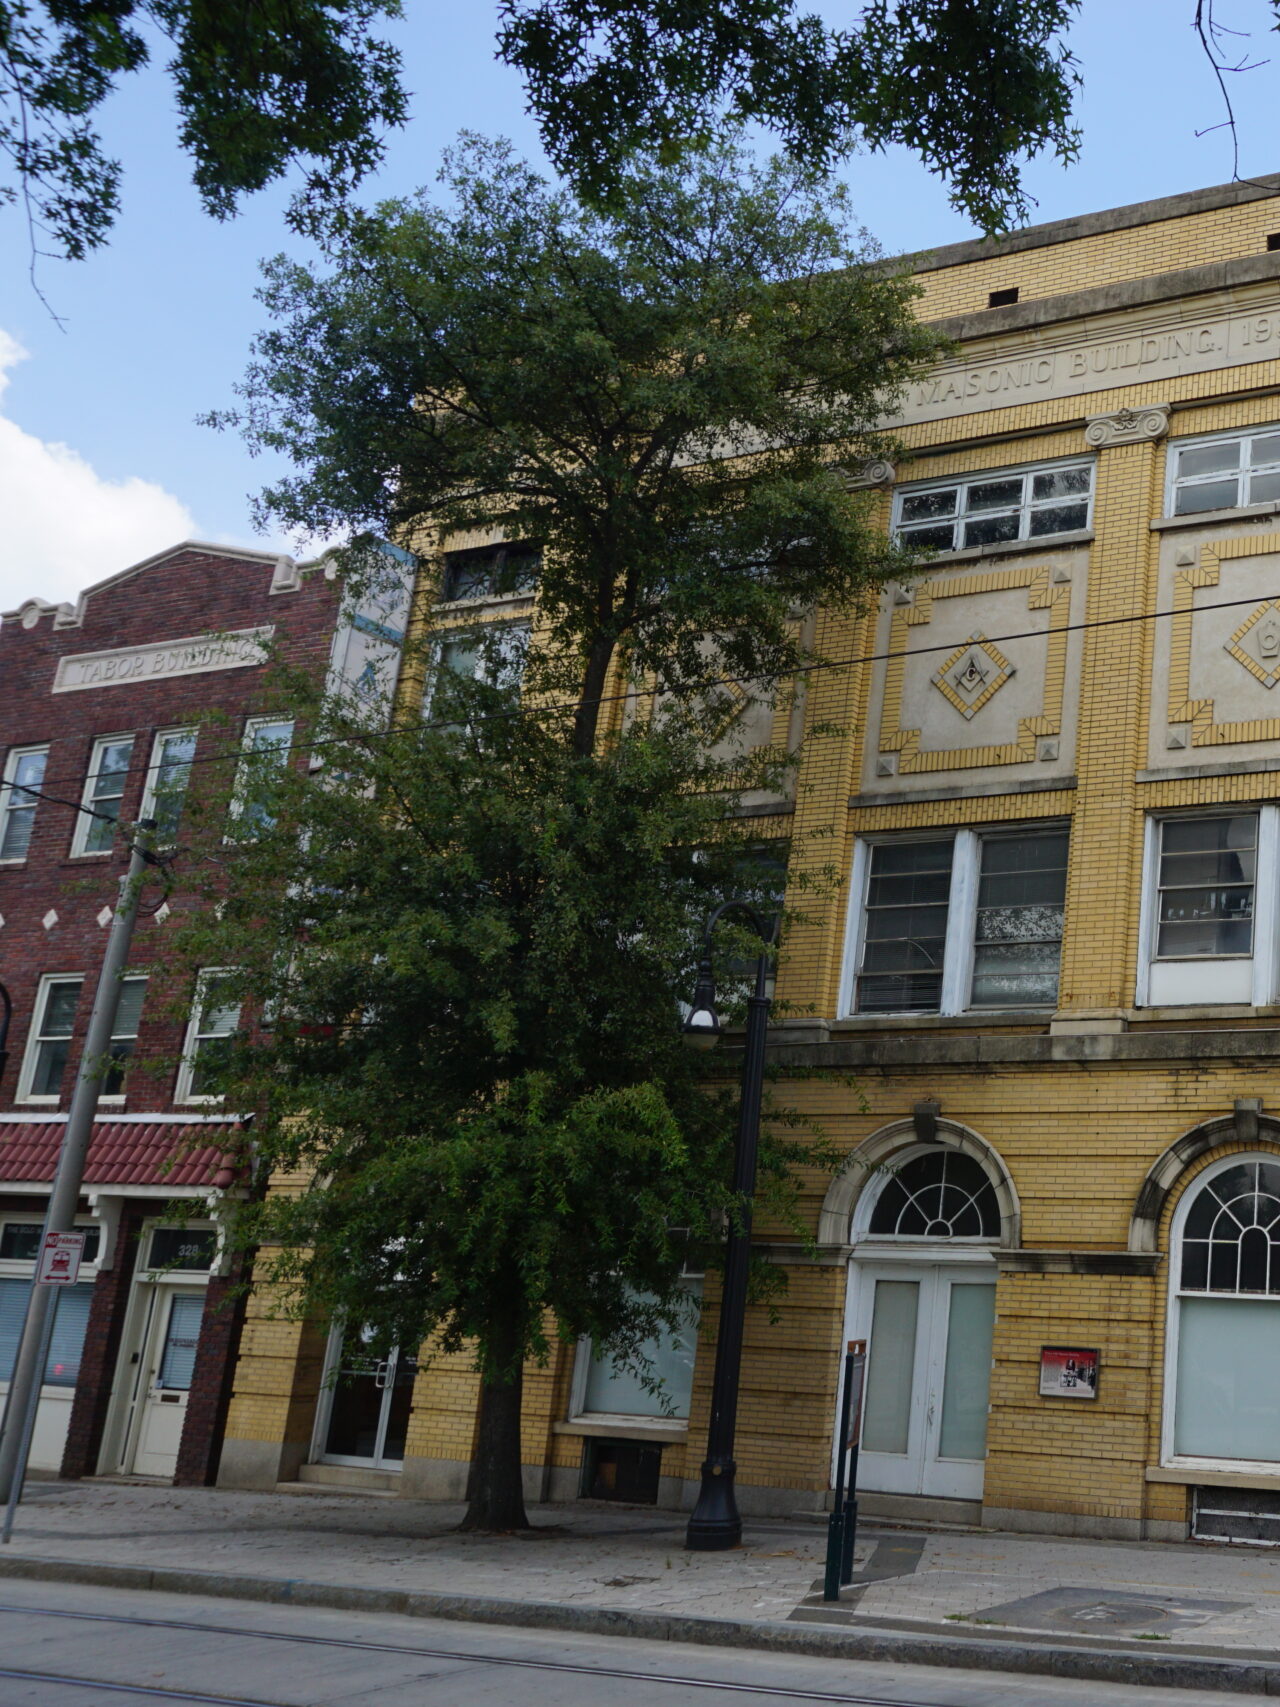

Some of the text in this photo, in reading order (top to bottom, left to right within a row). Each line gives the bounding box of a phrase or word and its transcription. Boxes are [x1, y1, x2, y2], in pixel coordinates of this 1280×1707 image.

[916, 361, 1052, 406] MASONIC
[80, 656, 145, 683] TABOR
[47, 1235, 83, 1246] NO PARKING
[178, 1244, 199, 1256] 328
